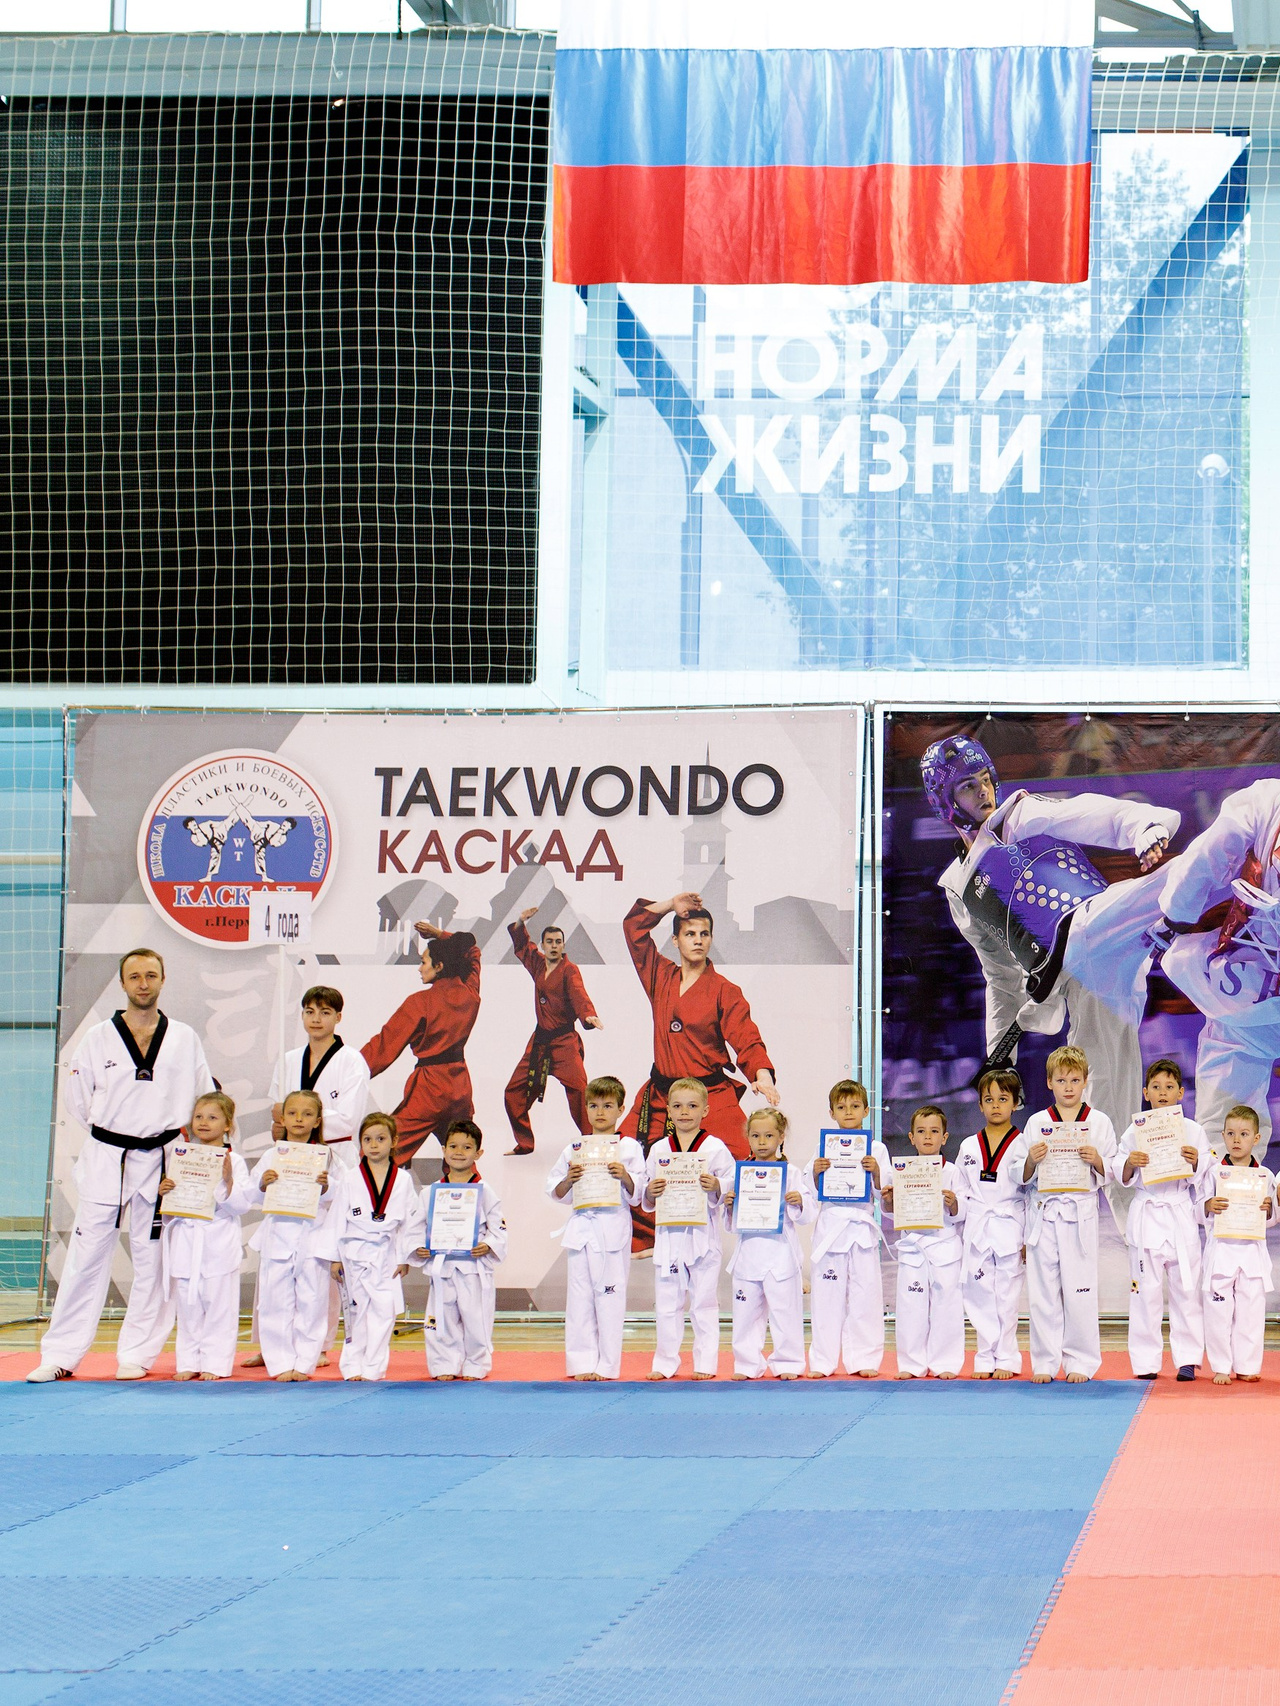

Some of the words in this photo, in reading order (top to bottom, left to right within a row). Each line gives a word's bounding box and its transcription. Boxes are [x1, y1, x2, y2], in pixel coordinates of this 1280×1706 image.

[697, 323, 1043, 402] НОРМА
[692, 414, 1042, 494] ЖИЗНИ
[194, 781, 289, 810] TAEKWONDO
[374, 763, 785, 817] TAEKWONDO
[152, 823, 167, 878] ШКОЛА
[161, 762, 228, 819] ПЛАСТИКИ
[235, 762, 245, 772] И
[252, 762, 308, 799] БОЕВЫХ
[303, 800, 329, 878] ИСКУССТВ
[377, 829, 624, 881] КАСКАД
[174, 885, 297, 909] КАСК
[264, 905, 271, 937] 4
[276, 909, 300, 943] года
[1031, 942, 1039, 953] 3
